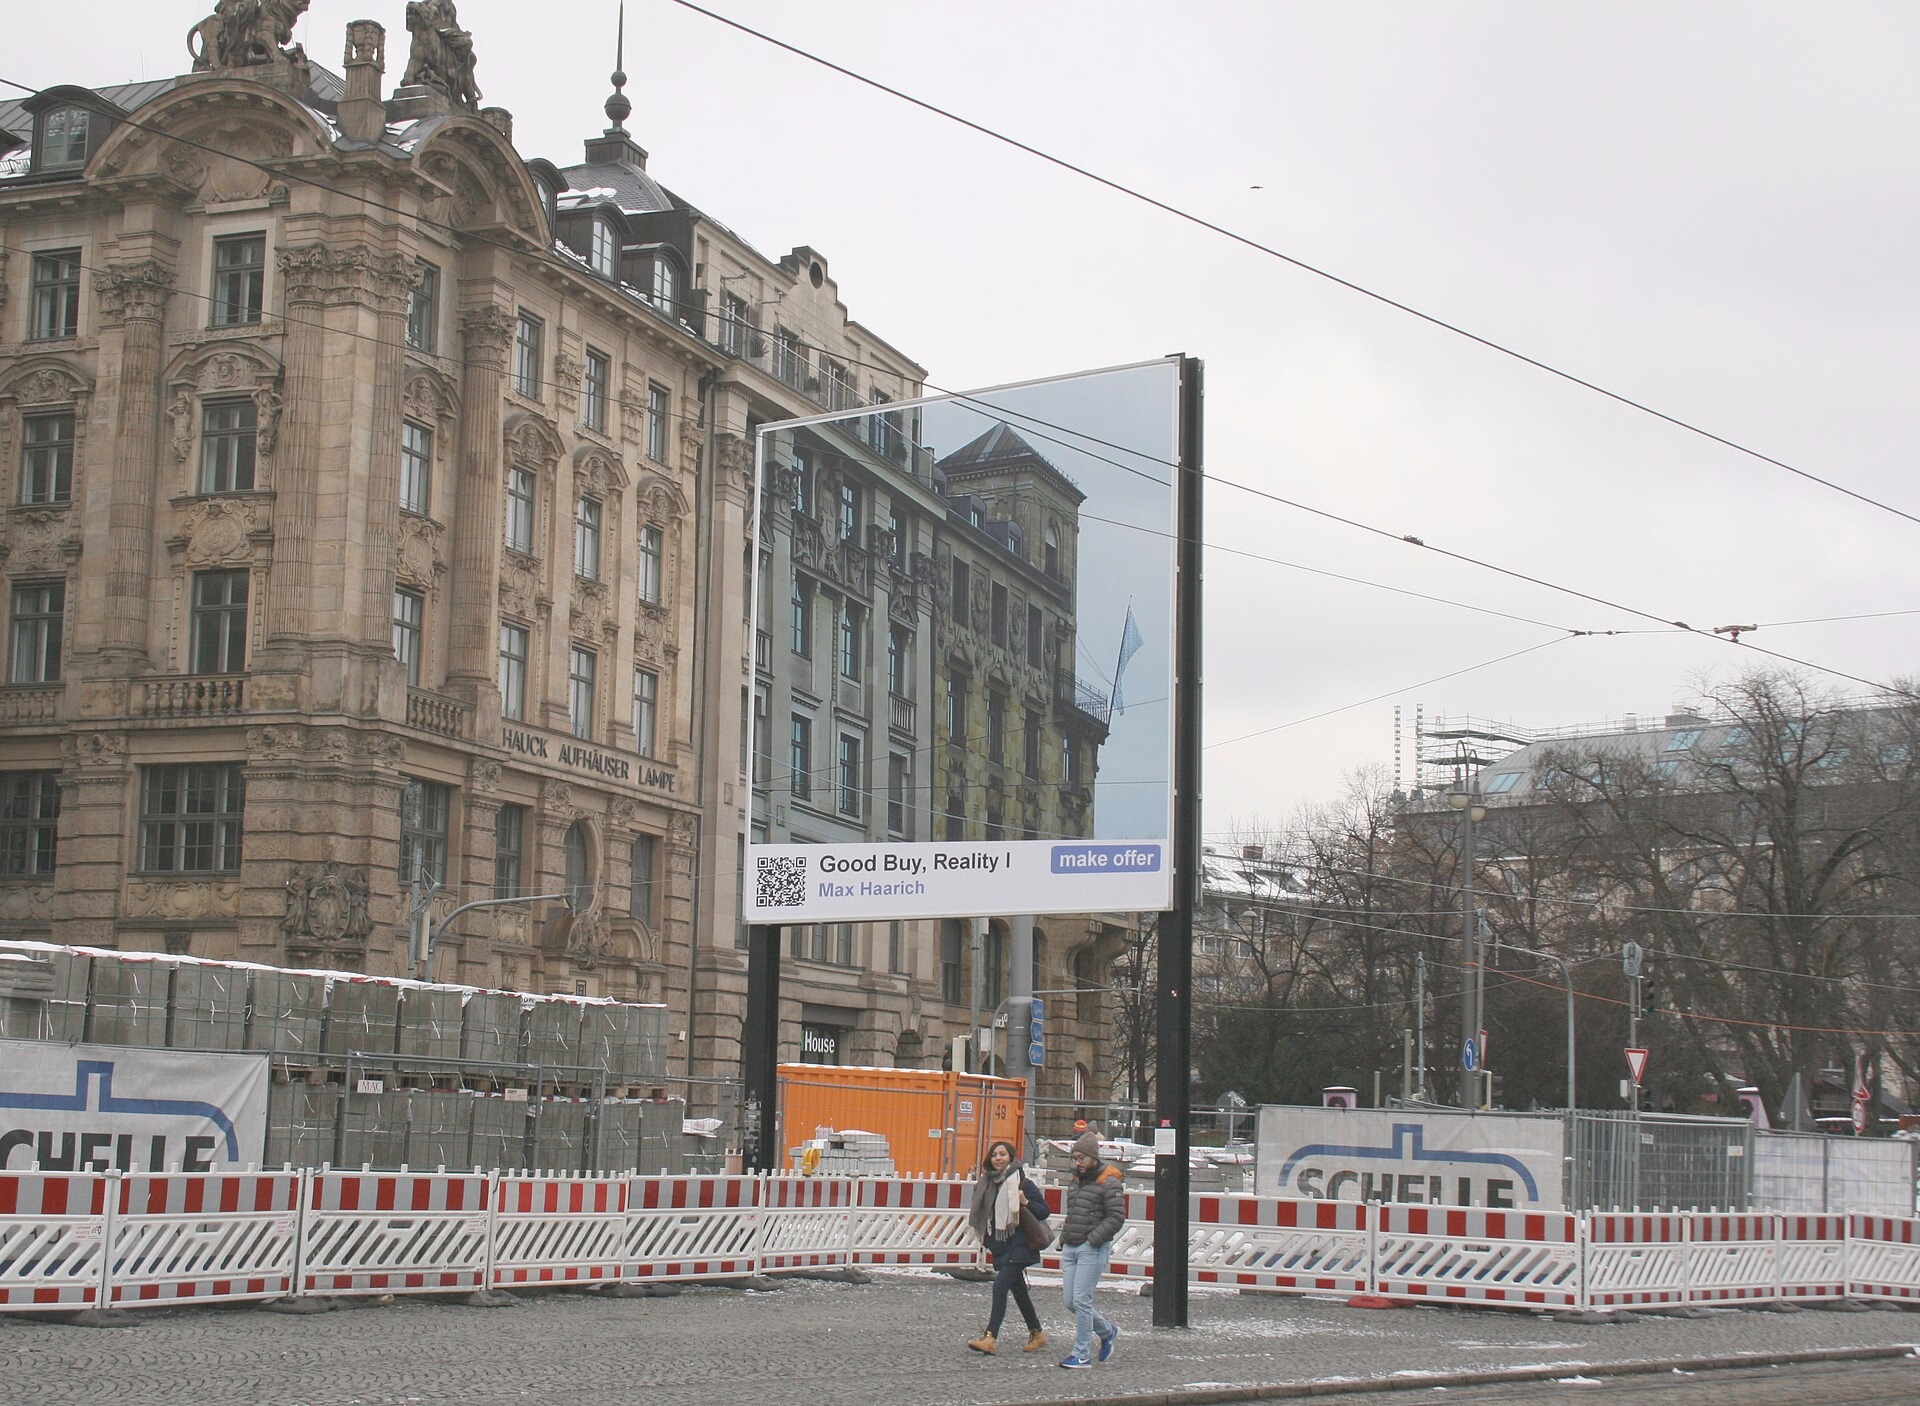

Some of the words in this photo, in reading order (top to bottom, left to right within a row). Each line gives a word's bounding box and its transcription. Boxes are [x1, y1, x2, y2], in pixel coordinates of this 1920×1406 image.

[502, 727, 548, 758] HAUCK
[558, 743, 629, 780] AUFHÄUSER
[638, 765, 676, 793] LAMPE
[819, 854, 877, 873] Good
[883, 854, 927, 875] Buy,
[934, 852, 999, 873] Reality
[1059, 850, 1108, 867] make
[1113, 849, 1155, 866] offer
[818, 882, 855, 897] Max
[860, 880, 925, 897] Haarich
[804, 1030, 835, 1054] House
[994, 1104, 1007, 1120] 49
